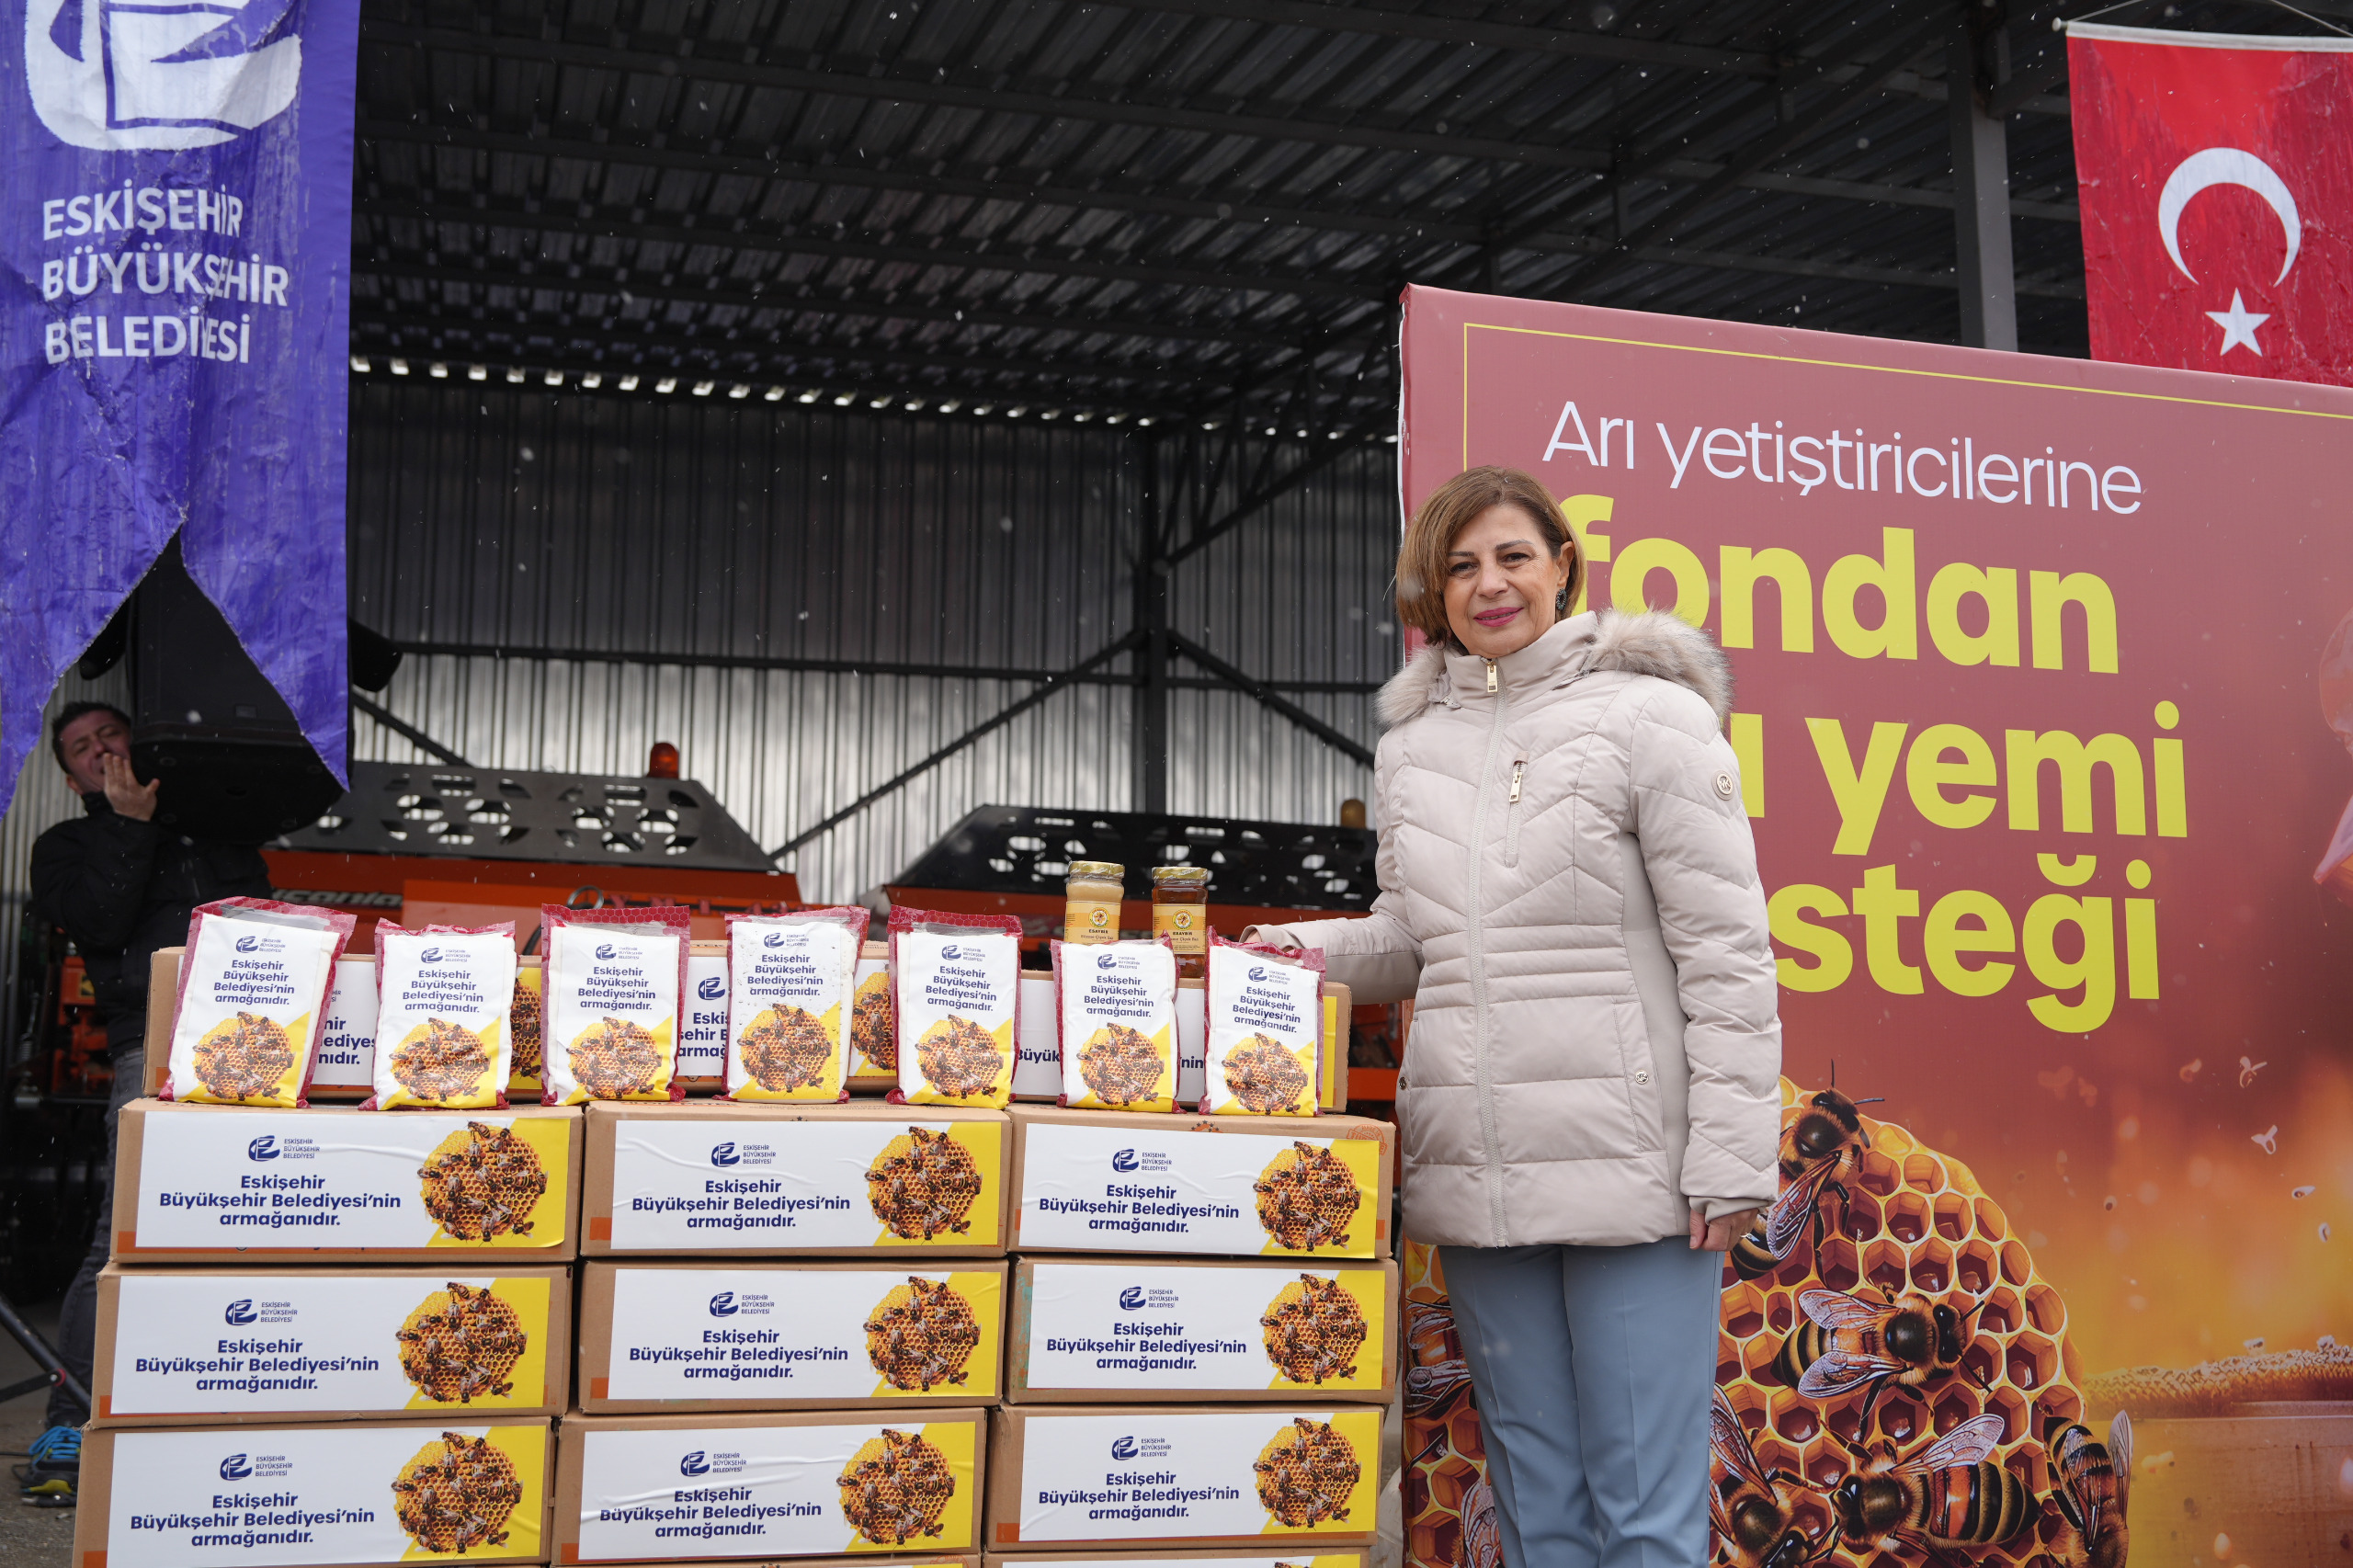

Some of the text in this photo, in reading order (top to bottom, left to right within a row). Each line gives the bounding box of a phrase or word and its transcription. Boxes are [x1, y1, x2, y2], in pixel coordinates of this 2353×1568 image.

[43, 178, 243, 241] ESKİŞEHİR
[43, 242, 289, 306] BÜYÜKŞEHİR
[1542, 400, 2142, 515] Arı yetiştiricilerine
[1560, 493, 2119, 674] fondan
[1805, 700, 2188, 856] yemi
[1768, 852, 2160, 1034] steği
[232, 960, 284, 970] Eskişehir
[762, 954, 810, 963] Eskişehir
[223, 970, 289, 982] Büyükşehir
[418, 969, 471, 979] Eskişehir
[593, 967, 643, 976] Eskişehir
[755, 965, 816, 975] Büyükşehir
[940, 966, 986, 978] Eskişehir
[214, 982, 295, 994] Belediyesi'nin
[411, 980, 476, 990] Büyükşehir
[587, 977, 649, 987] Büyükşehir
[747, 976, 823, 985] Belediyesi'nin
[933, 975, 990, 990] Büyükşehir
[1097, 975, 1141, 985] Eskişehir
[403, 992, 483, 1002] Belediyesi'nin
[578, 988, 656, 999] Belediyesi'nin
[750, 987, 820, 997] armağanıdır.
[926, 986, 997, 1001] Belediyesi'nin
[1091, 985, 1147, 996] Büyükşehir
[1246, 986, 1291, 1000] Eskişehir
[215, 994, 290, 1005] armağanıdır.
[405, 1002, 480, 1013] armağanıdır.
[580, 1000, 652, 1010] armağanıdır.
[928, 996, 993, 1011] armağanıdır.
[1084, 996, 1154, 1007] Belediyesi'nin
[1240, 996, 1296, 1011] Büyükşehir
[1086, 1007, 1151, 1017] armağanıdır.
[1232, 1005, 1301, 1023] Belediyesi'nin
[1234, 1015, 1297, 1033] armağanıdır.
[241, 1174, 325, 1192] Eskişehir
[705, 1179, 782, 1195] Eskişehir
[1106, 1184, 1176, 1201] Eskişehir
[160, 1192, 401, 1210] Büyükşehir Belediyesi'nin
[632, 1195, 850, 1213] Büyükşehir Belediyesi'nin
[1039, 1198, 1239, 1219] Büyükşehir Belediyesi'nin
[220, 1210, 341, 1228] armağanıdır.
[687, 1214, 796, 1230] armağanıdır.
[1088, 1217, 1190, 1234] armağanıdır.
[702, 1329, 780, 1346] Eskişehir
[1114, 1322, 1184, 1338] Eskişehir
[217, 1338, 303, 1356] Eskişehir
[630, 1346, 848, 1363] Büyükşehir Belediyesi'nin
[1047, 1339, 1247, 1356] Büyükşehir Belediyesi'nin
[135, 1356, 379, 1374] Büyükşehir Belediyesi'nin
[1096, 1355, 1196, 1372] armağanıdır.
[684, 1364, 793, 1381] armağanıdır.
[196, 1375, 318, 1393] armağanıdır.
[255, 1462, 293, 1470] BÜYÜKŞEHİR
[1106, 1471, 1176, 1487] Eskişehir
[212, 1492, 298, 1511] Eskişehir
[674, 1486, 752, 1504] Eskişehir
[1039, 1486, 1239, 1505] Büyükşehir Belediyesi'nin
[131, 1508, 375, 1531] Büyükşehir Belediyesi'nin
[599, 1503, 822, 1522] Büyükşehir Belediyesi'nin
[1088, 1504, 1189, 1520] armağanıdır.
[191, 1528, 314, 1547] armağanıdır.
[655, 1522, 766, 1539] armağanıdır.
